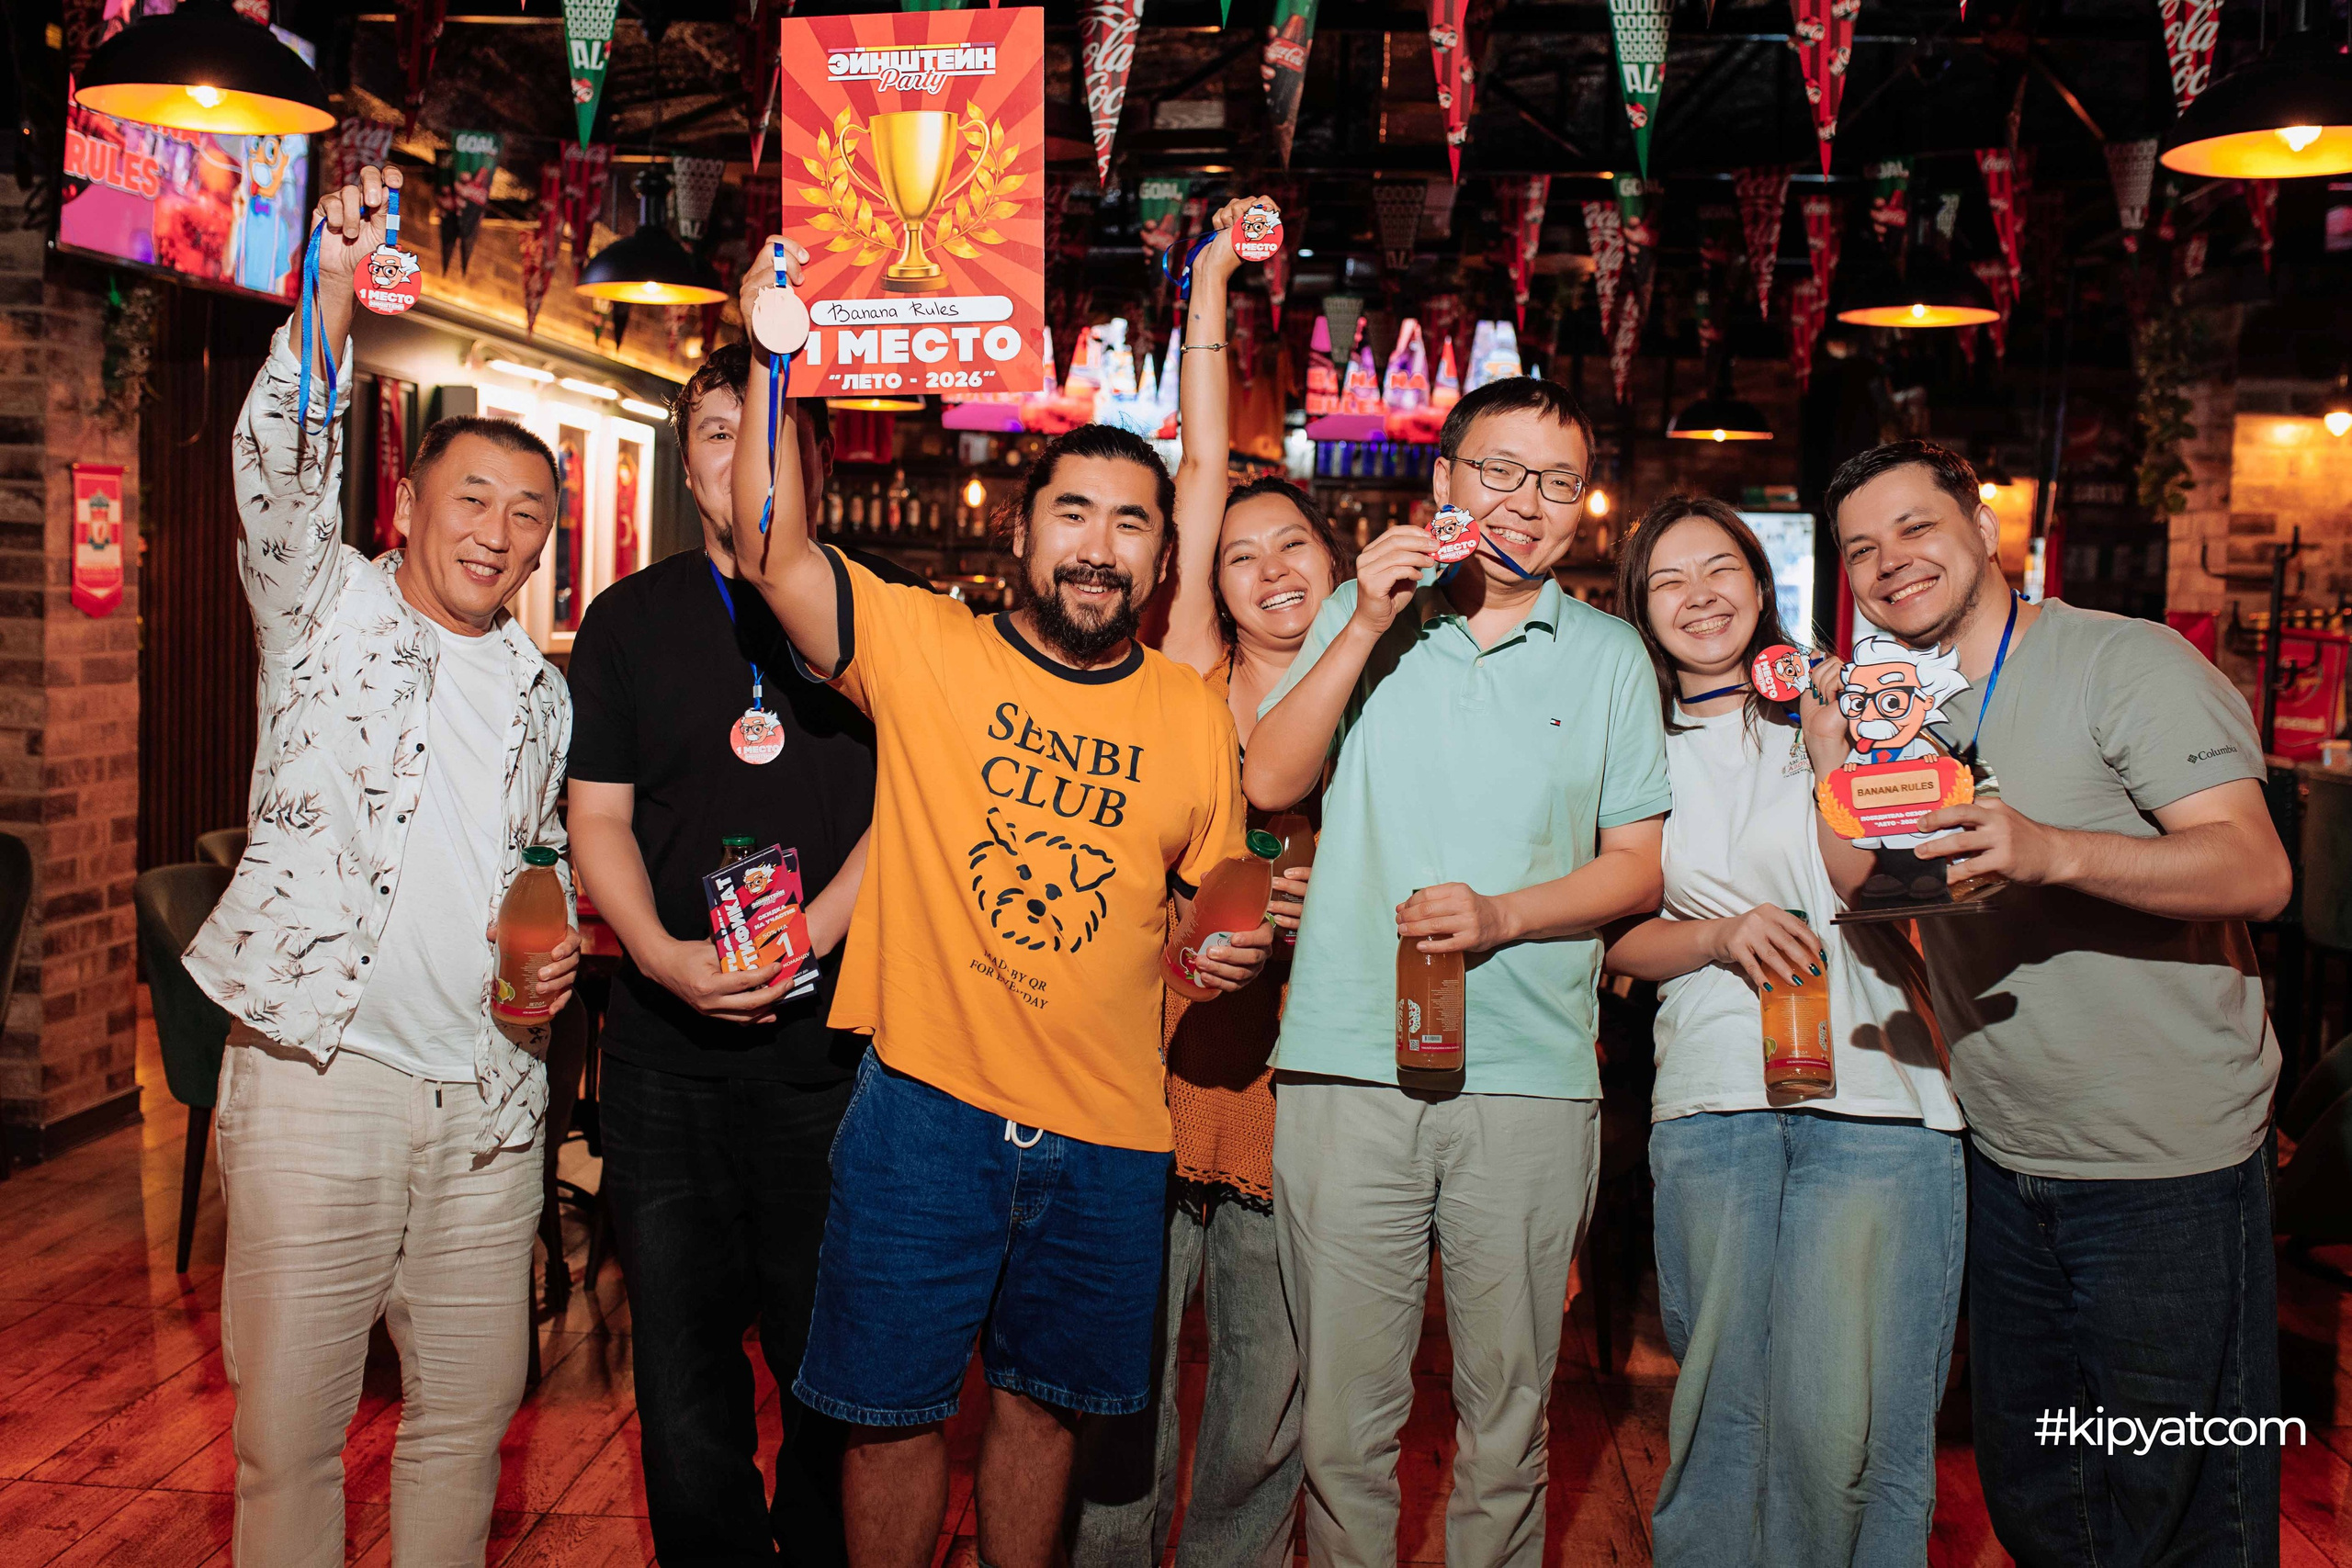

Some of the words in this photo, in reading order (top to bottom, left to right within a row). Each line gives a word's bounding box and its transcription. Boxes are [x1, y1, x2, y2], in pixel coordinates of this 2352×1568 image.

[827, 44, 996, 75] ЭЙНШТЕЙН
[877, 67, 947, 95] Party
[64, 129, 160, 200] RULES
[359, 288, 367, 299] 1
[368, 289, 415, 305] МЕСТО
[828, 303, 899, 322] Banana
[909, 300, 959, 317] Rules
[838, 325, 1022, 365] МЕСТО
[988, 702, 1145, 783] SENBI
[2198, 745, 2238, 761] Columbia
[981, 756, 1127, 828] CLUB
[1857, 784, 1899, 797] BANANA
[1901, 781, 1934, 793] RULES
[776, 931, 795, 958] 1
[783, 952, 810, 968] КОМАНДУ
[969, 959, 994, 977] FOR
[1011, 969, 1027, 983] BY
[1028, 977, 1047, 992] QR
